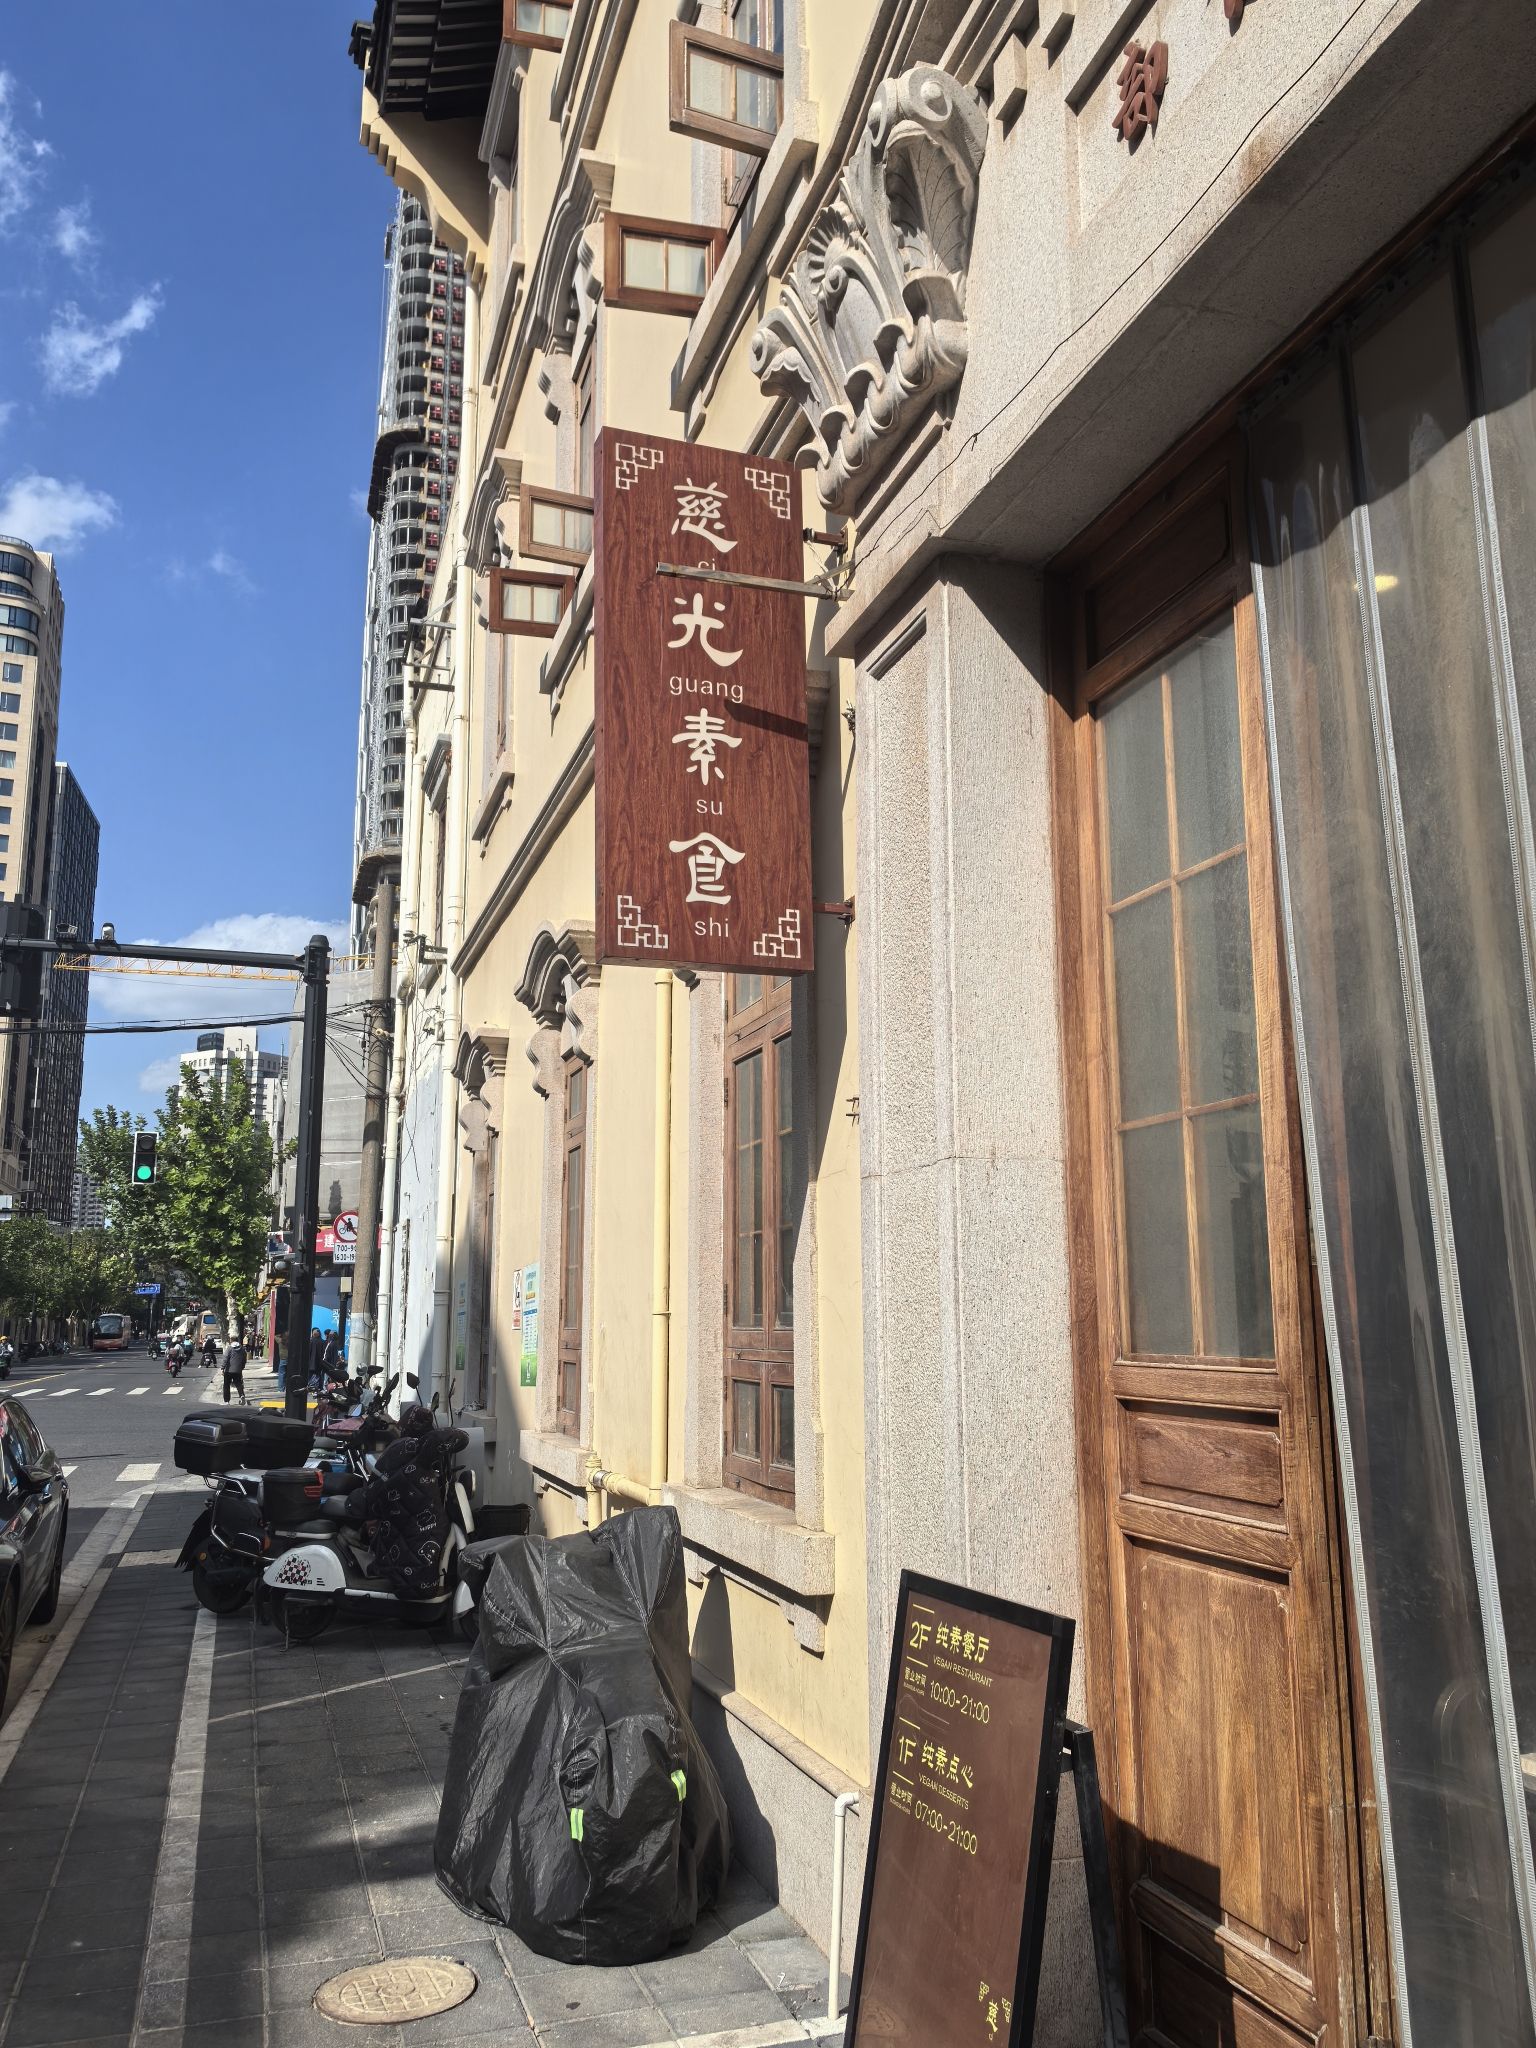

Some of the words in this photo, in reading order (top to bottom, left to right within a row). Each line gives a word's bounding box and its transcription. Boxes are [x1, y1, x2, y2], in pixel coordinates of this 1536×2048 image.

[669, 676, 744, 704] guang
[696, 799, 723, 815] su
[694, 917, 729, 937] shi
[909, 1621, 932, 1650] 2F
[936, 1621, 990, 1664] 纯素餐厅
[933, 1654, 953, 1671] VEGAN
[952, 1663, 993, 1688] RESTAURANT
[930, 1680, 990, 1724] 10:00-21:00
[898, 1735, 917, 1765] 1F
[921, 1739, 974, 1789] 纯素点心
[918, 1772, 939, 1792] VEGAN
[937, 1784, 970, 1810] DESSERTS
[915, 1800, 978, 1855] 07:00-21:00
